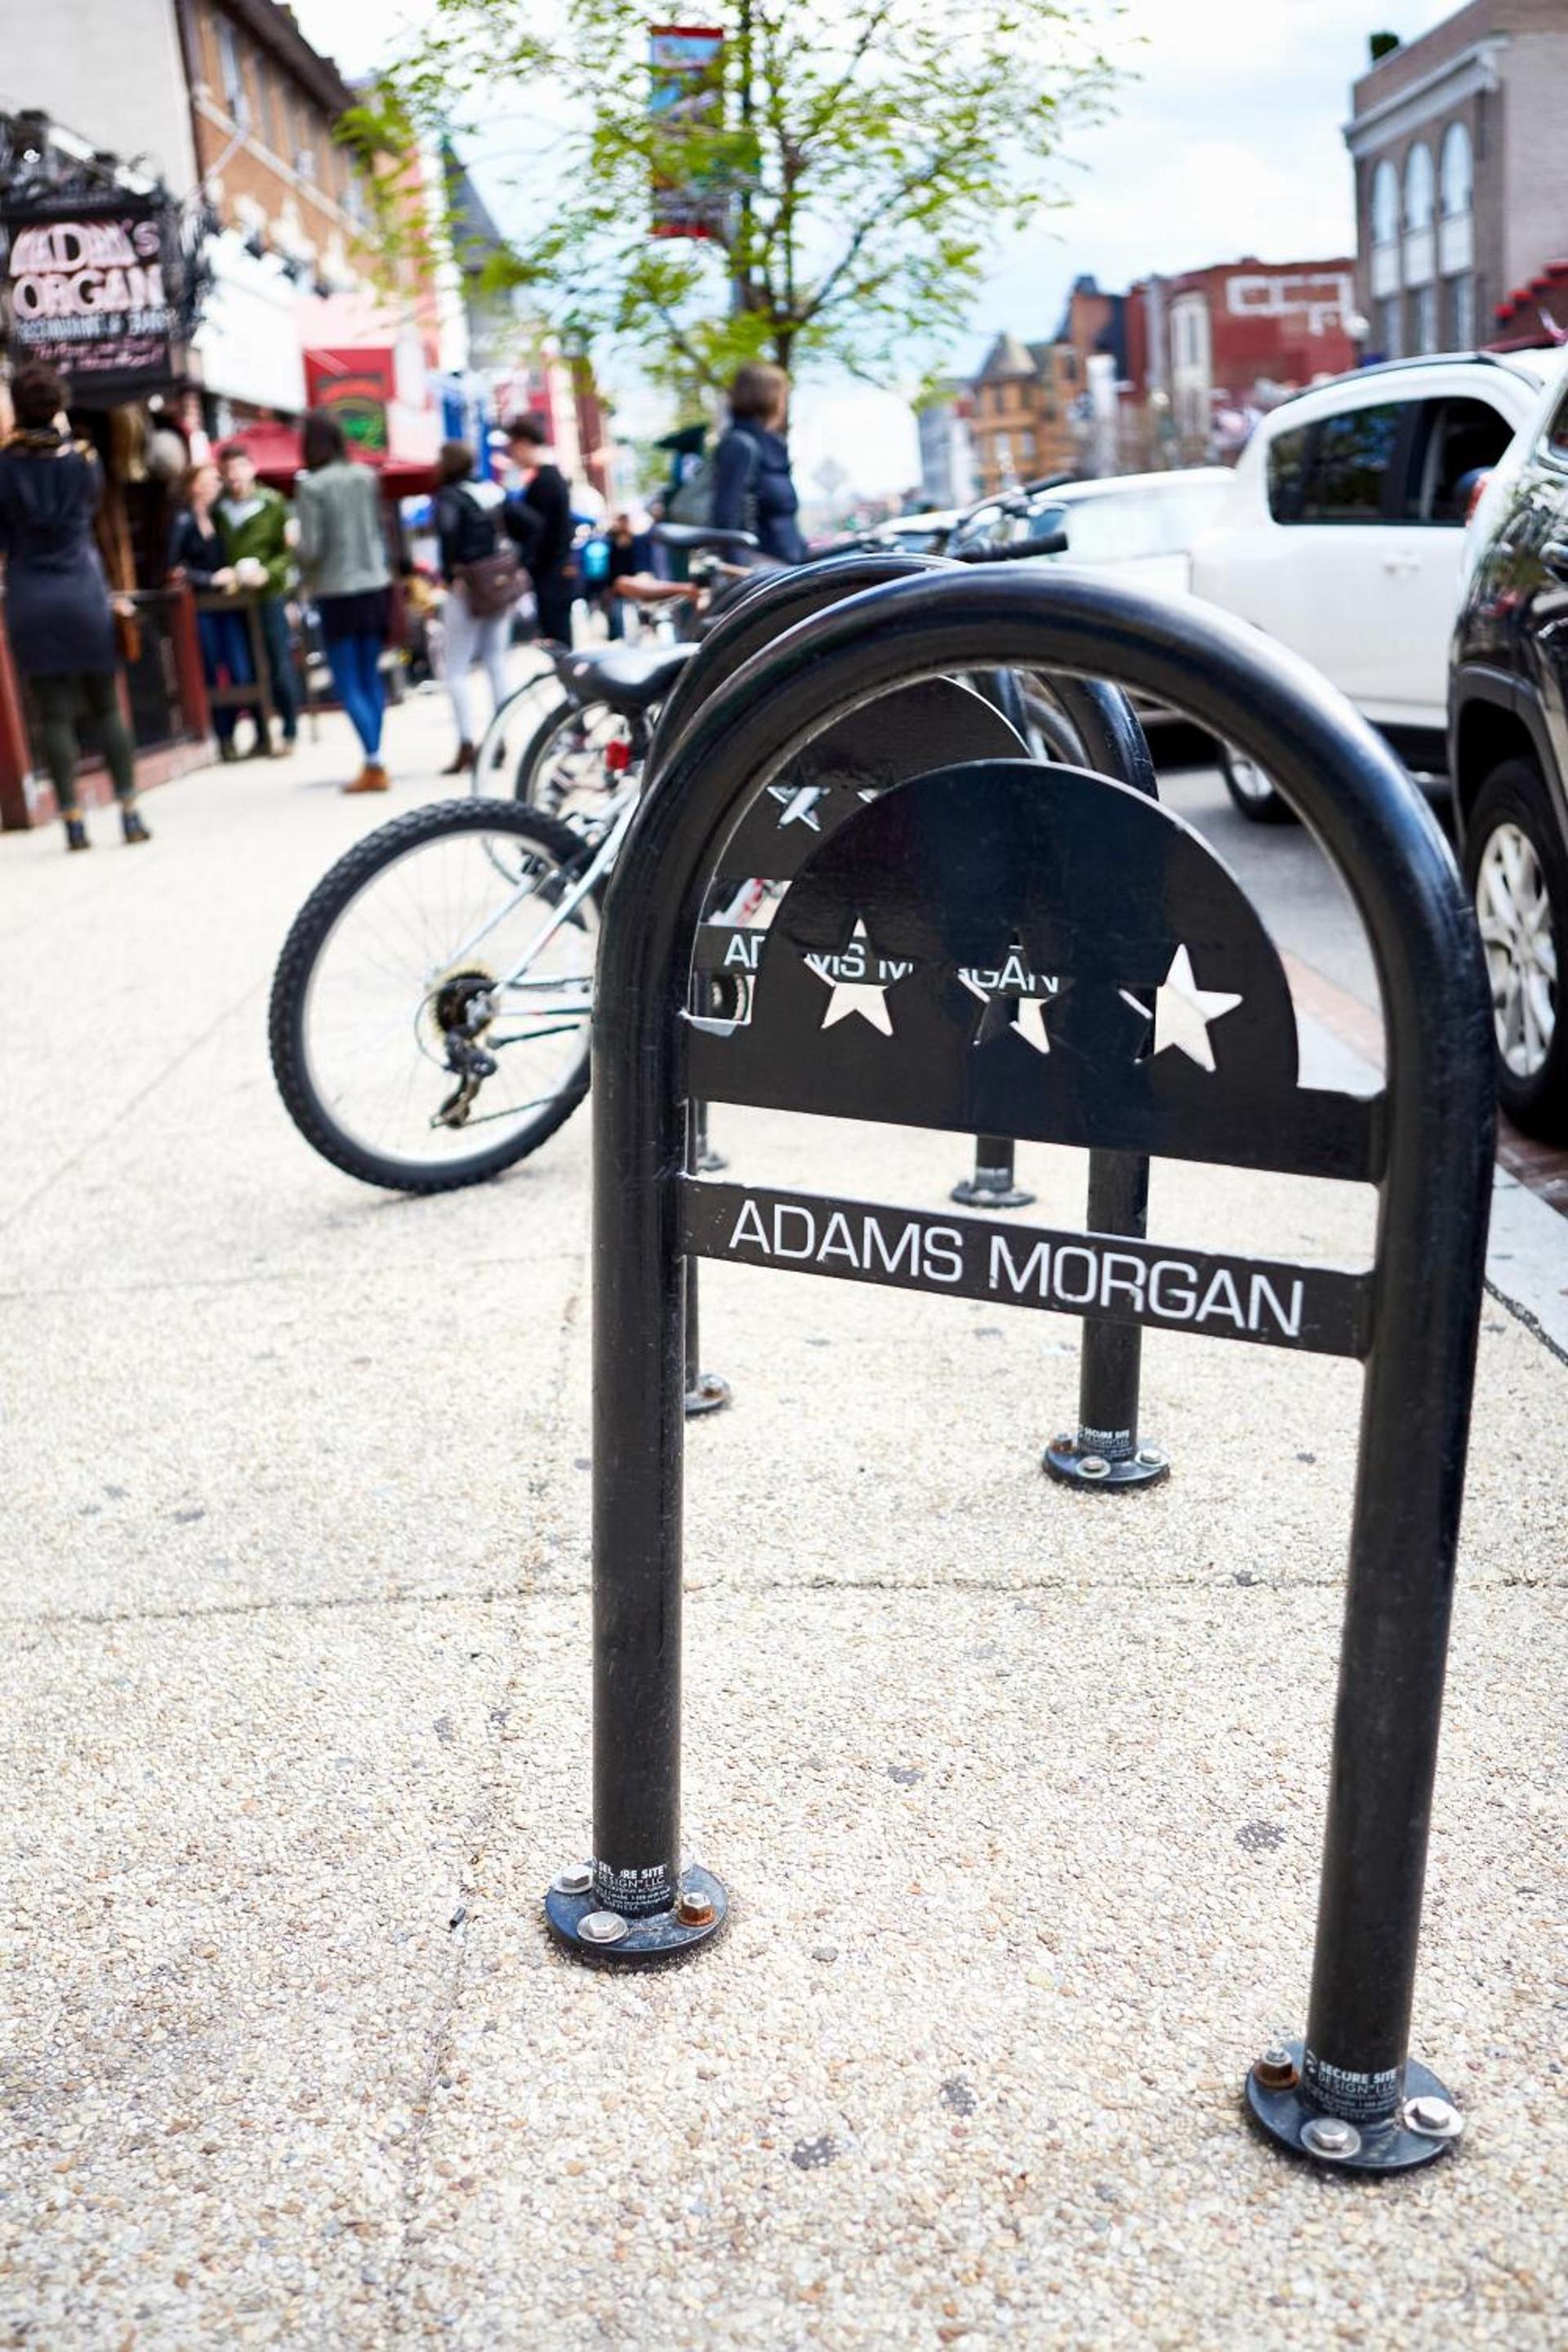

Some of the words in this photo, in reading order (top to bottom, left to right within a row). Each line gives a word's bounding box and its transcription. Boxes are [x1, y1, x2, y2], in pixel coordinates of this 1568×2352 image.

[728, 1199, 964, 1283] ADAMS
[988, 1235, 1304, 1338] MORGAN
[641, 1864, 665, 1879] SITE
[644, 1874, 666, 1887] LLC
[1319, 2060, 1370, 2083] SECURE
[1374, 2068, 1397, 2083] SITE
